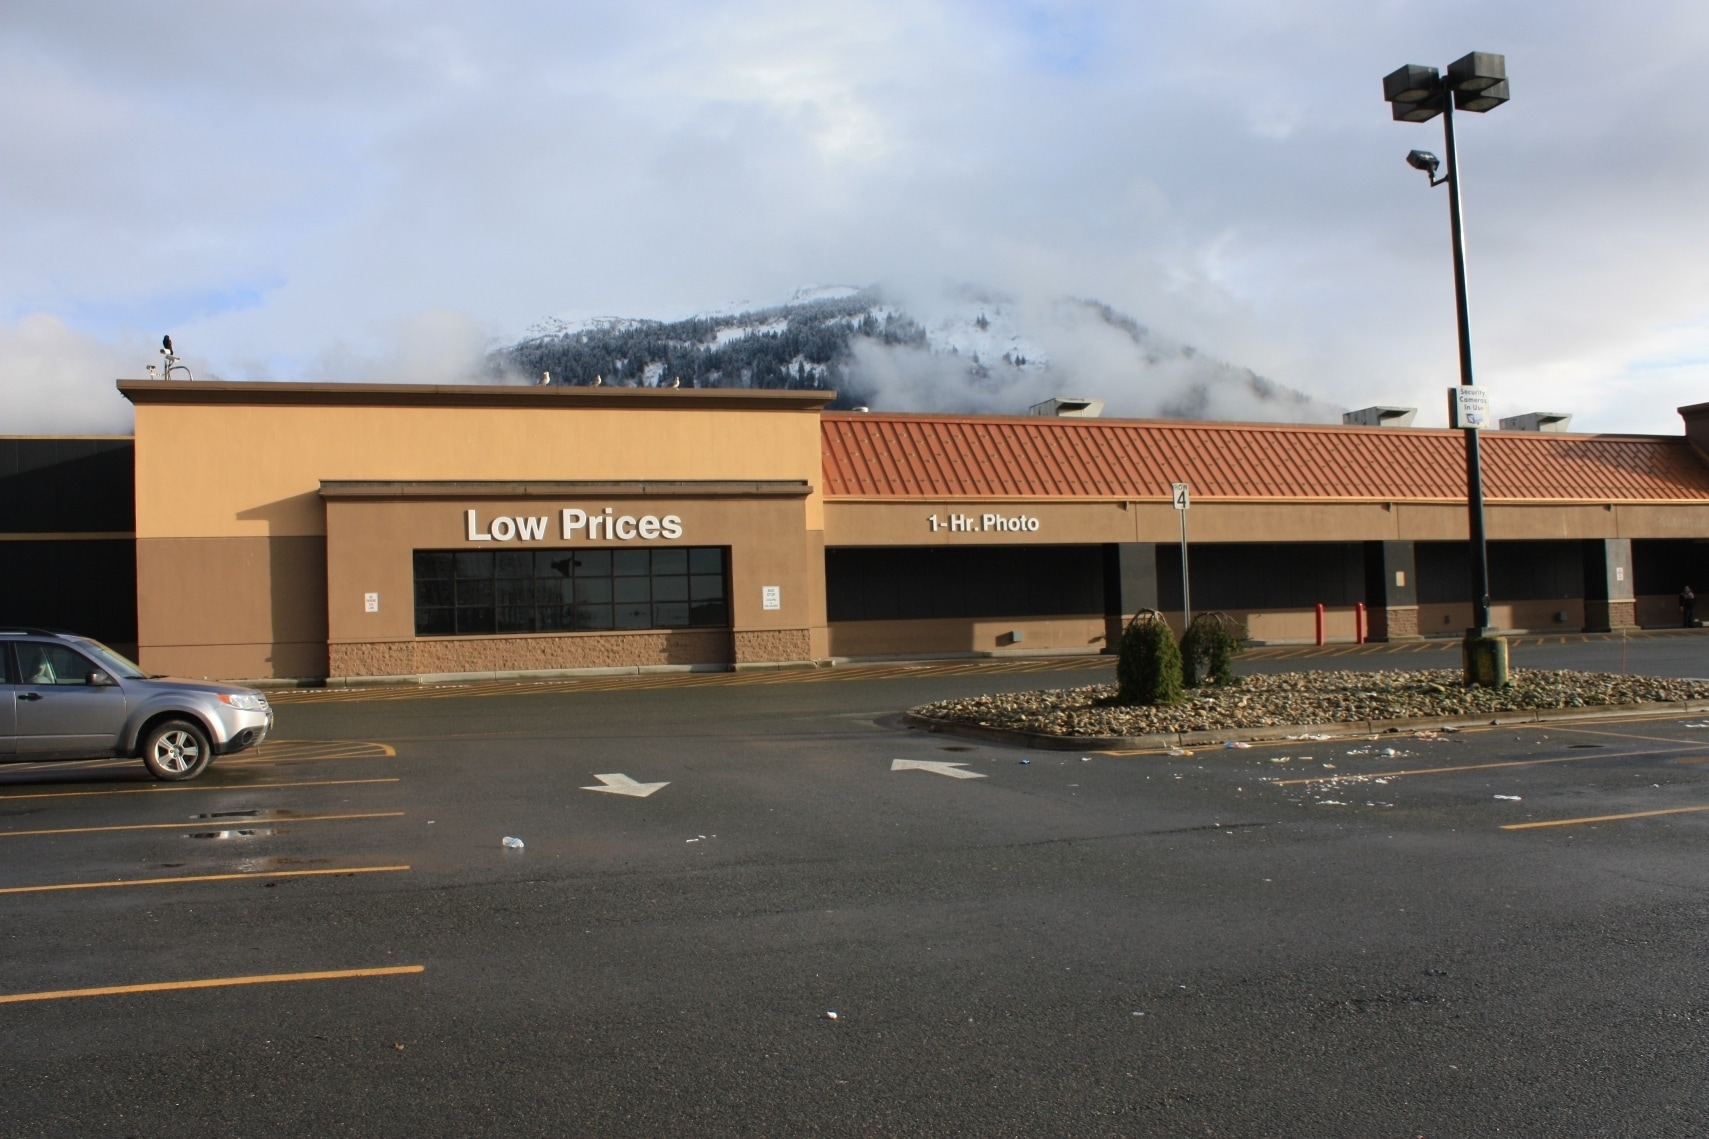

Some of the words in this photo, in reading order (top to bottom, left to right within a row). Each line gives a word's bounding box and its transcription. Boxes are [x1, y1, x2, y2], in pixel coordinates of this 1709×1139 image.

[1459, 396, 1487, 404] Cameras
[1460, 388, 1486, 397] Security
[1176, 490, 1187, 509] 4
[467, 509, 548, 541] Low
[562, 507, 683, 541] Prices
[982, 513, 1040, 532] Photo
